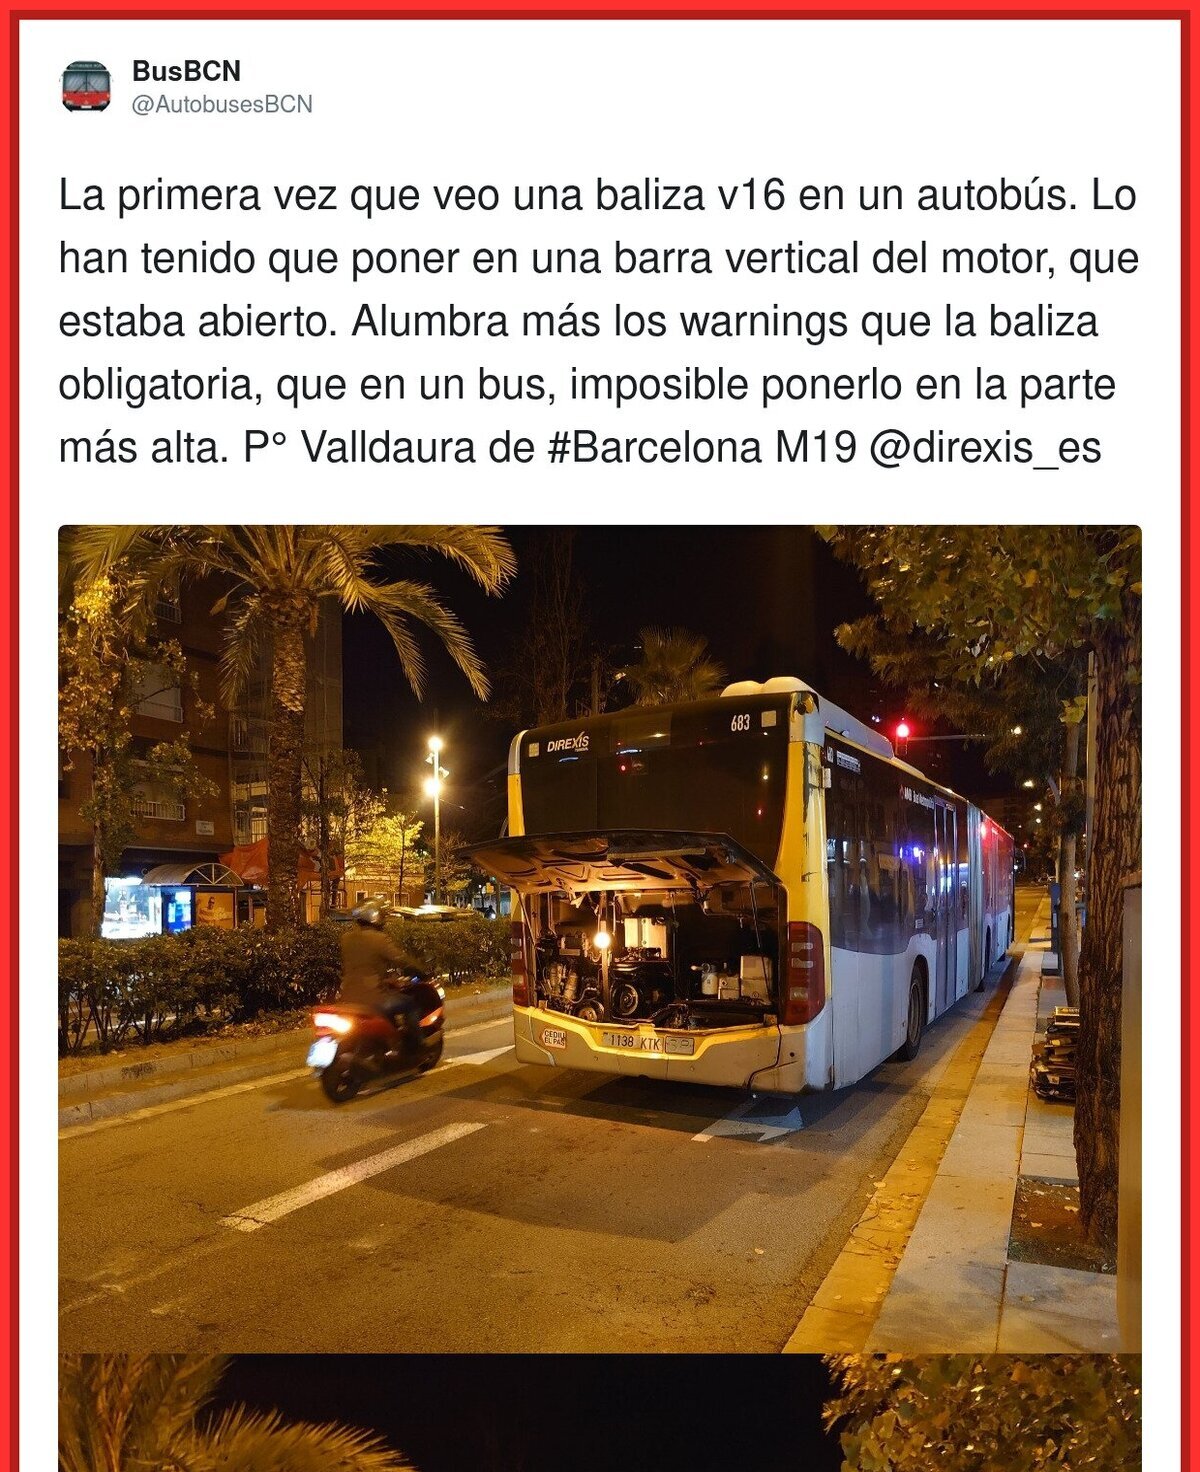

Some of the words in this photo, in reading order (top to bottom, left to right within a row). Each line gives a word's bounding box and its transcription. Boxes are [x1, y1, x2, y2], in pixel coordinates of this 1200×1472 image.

[731, 714, 750, 732] 683
[547, 731, 590, 753] DIREXIS
[612, 1034, 634, 1048] 1138
[641, 1037, 661, 1051] KTK
